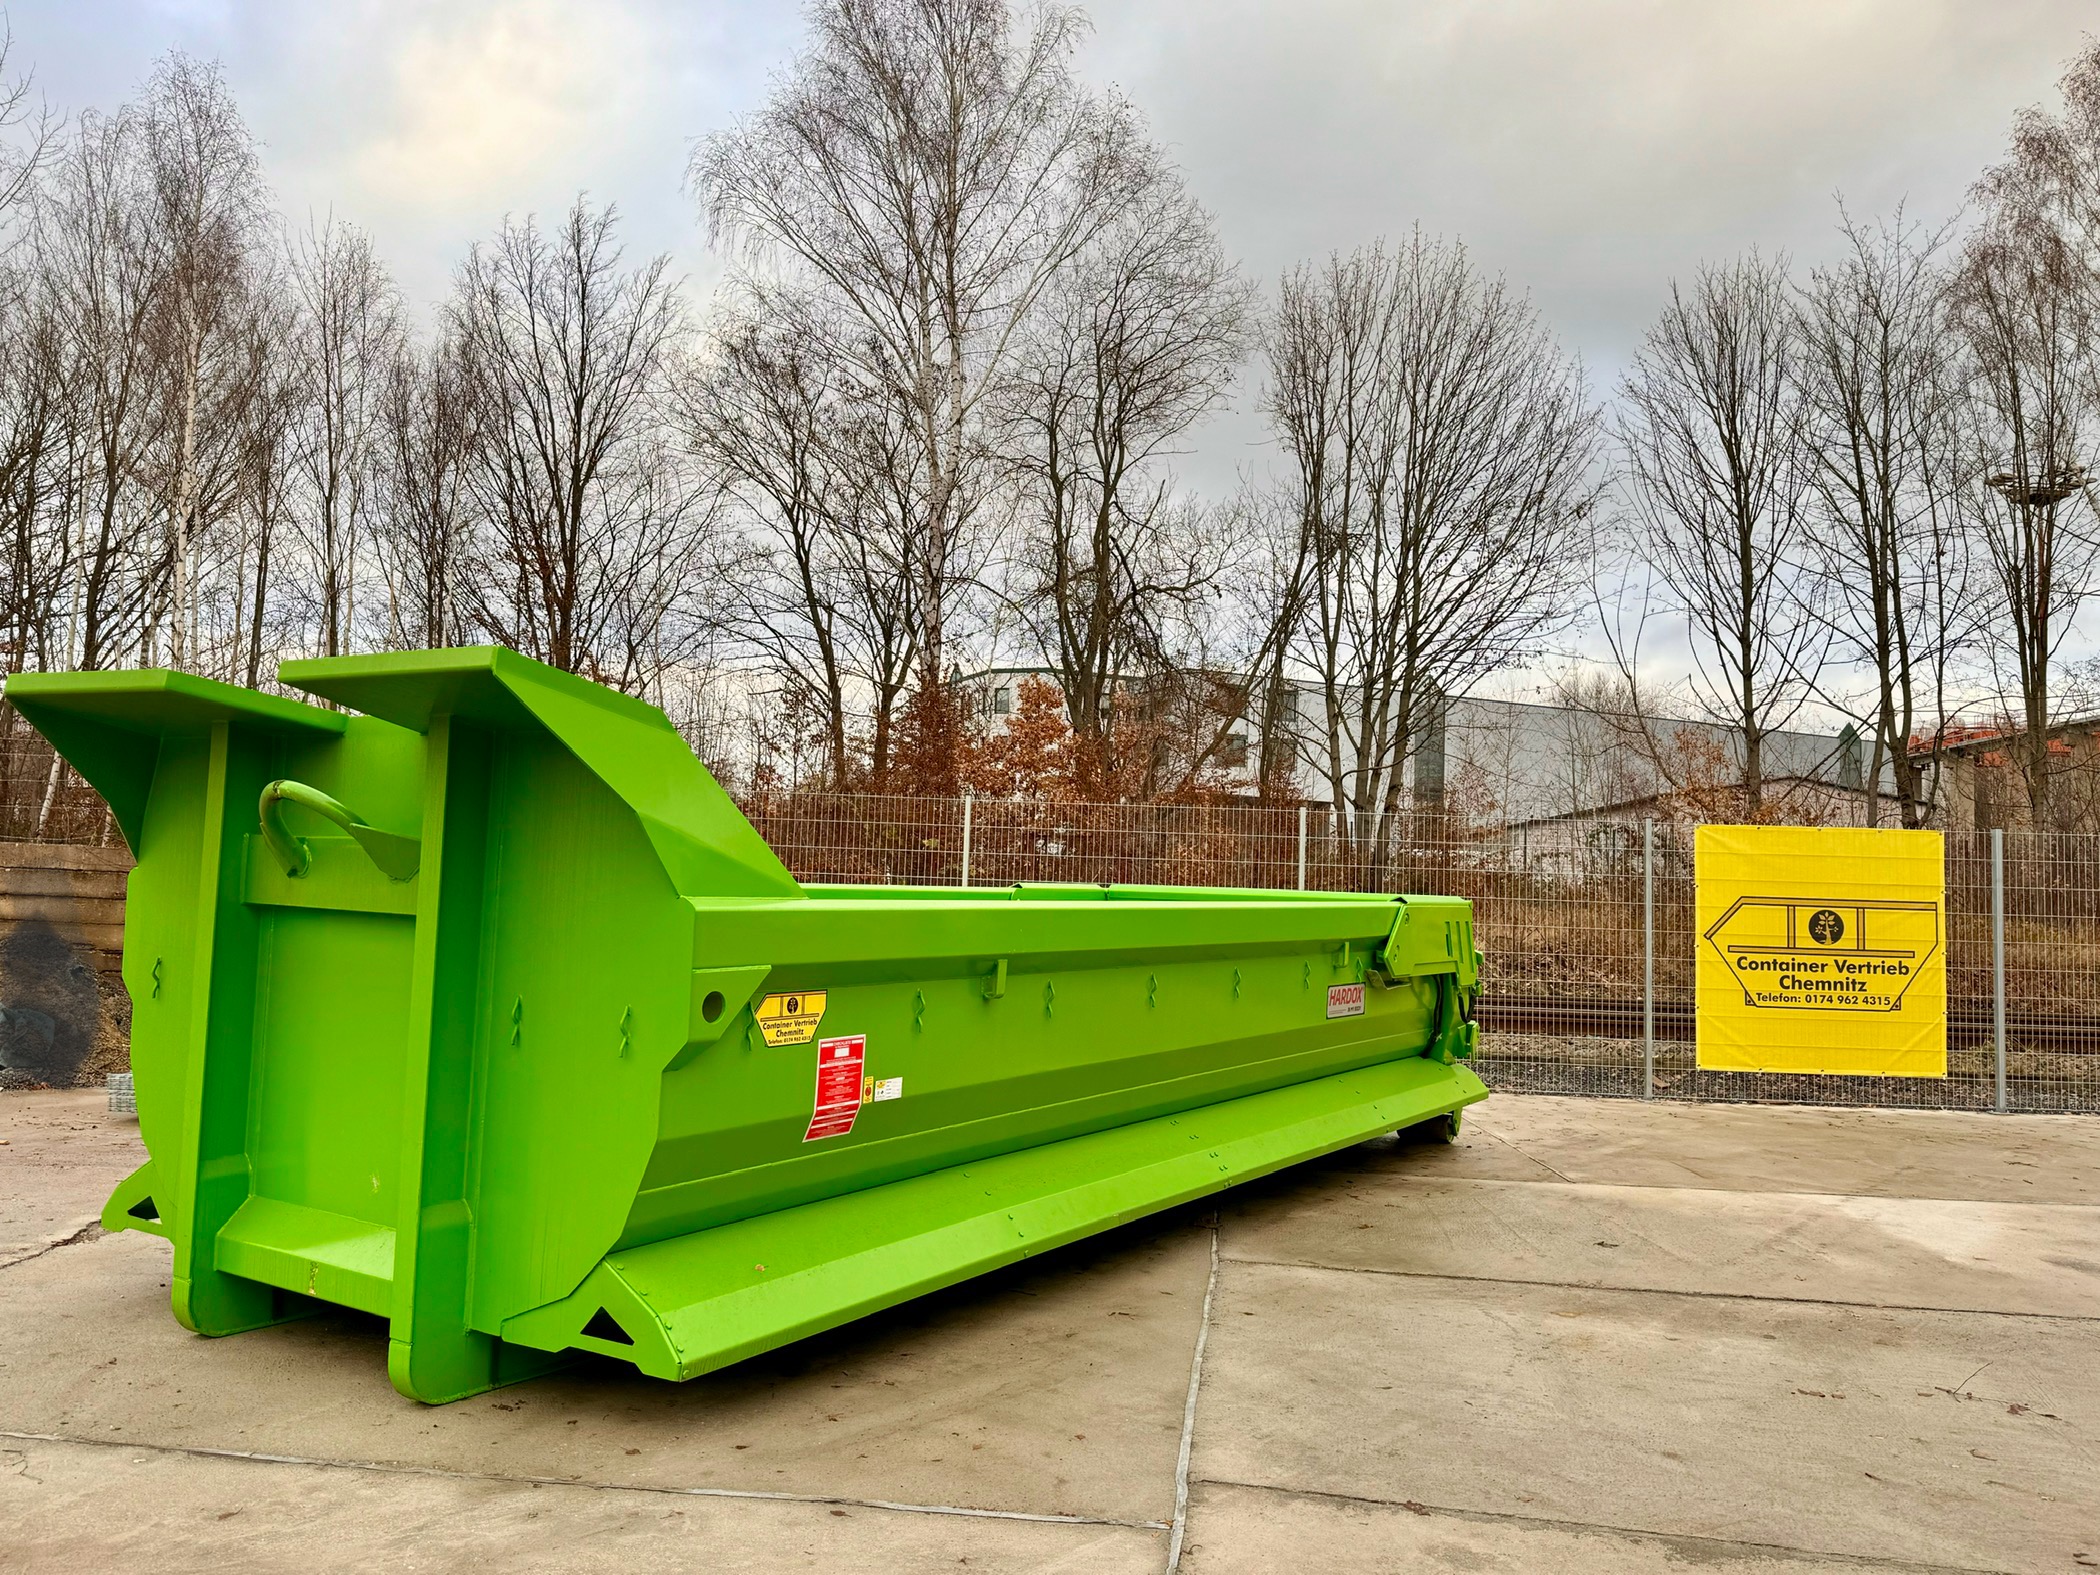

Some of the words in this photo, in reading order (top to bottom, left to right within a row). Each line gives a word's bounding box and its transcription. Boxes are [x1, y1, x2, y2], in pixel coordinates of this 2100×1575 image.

[1736, 956, 1828, 973] Container
[1833, 959, 1910, 976] Vertrieb
[1779, 975, 1867, 992] Chemnitz
[1329, 987, 1363, 1006] HARDOX
[1756, 992, 1801, 1003] Telefon:
[1805, 994, 1833, 1004] 0174
[1837, 995, 1859, 1005] 962
[1862, 995, 1891, 1006] 4315
[762, 1021, 792, 1030] Container
[794, 1018, 817, 1027] Vertrieb
[776, 1028, 804, 1037] Chemnitz
